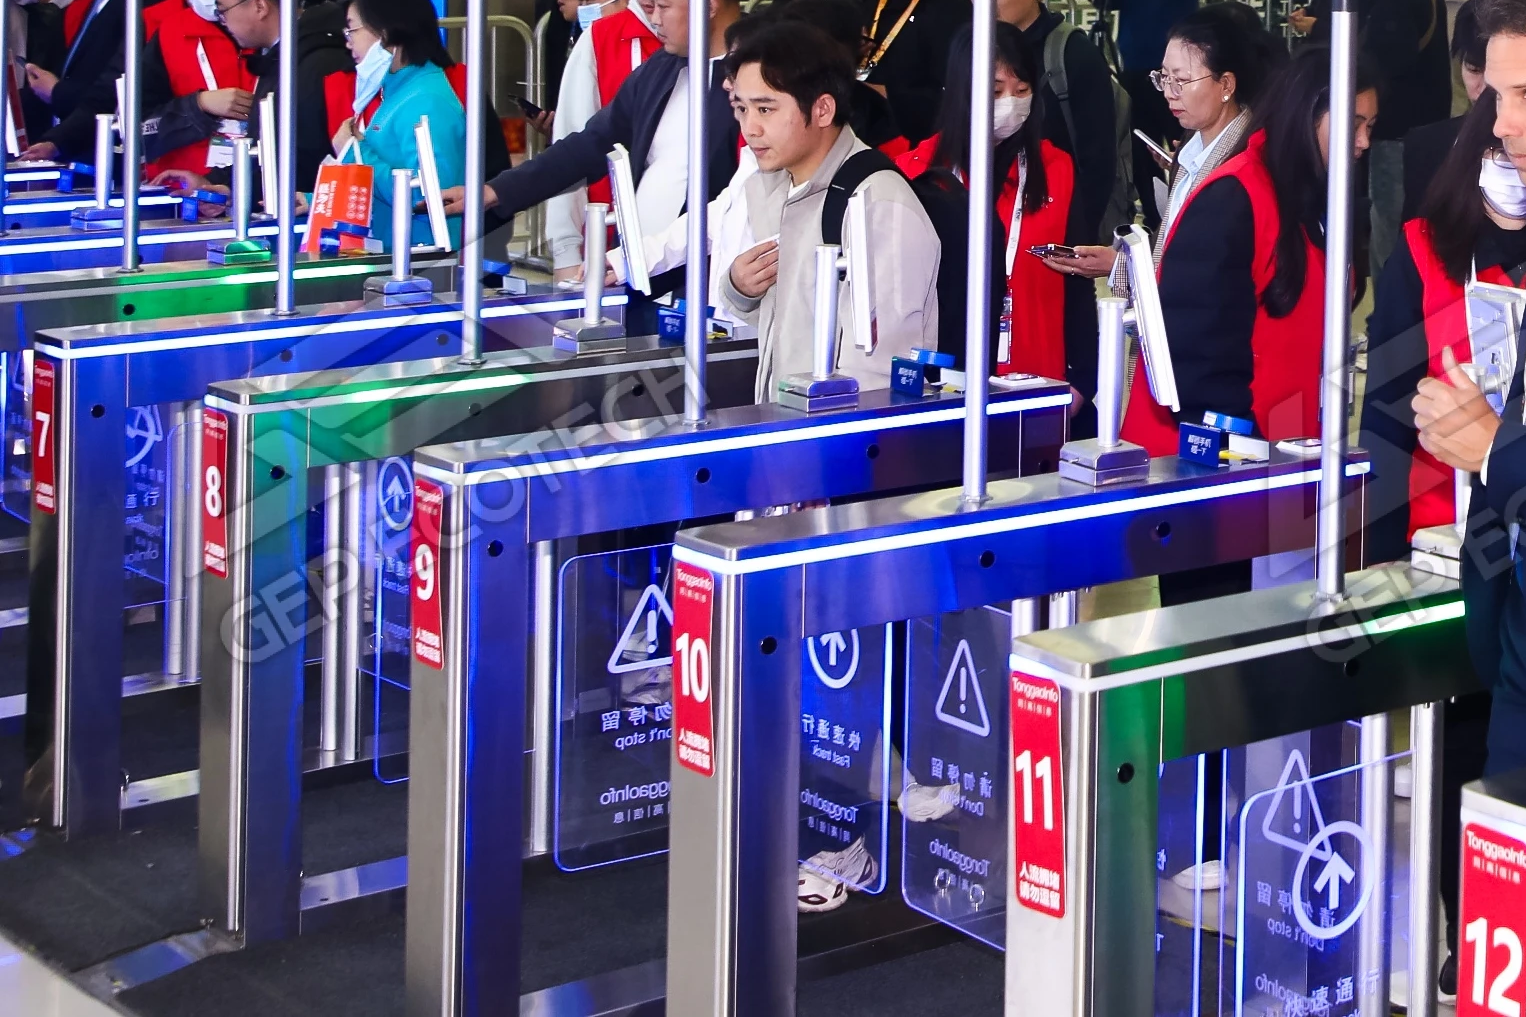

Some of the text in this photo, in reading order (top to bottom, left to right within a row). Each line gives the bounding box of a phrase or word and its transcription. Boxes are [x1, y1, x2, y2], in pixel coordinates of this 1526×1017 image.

[35, 410, 51, 458] 7
[205, 465, 222, 517] 8
[415, 543, 434, 601] 9
[675, 632, 710, 703] 10
[1015, 749, 1054, 832] 11
[1465, 917, 1523, 1017] 12
